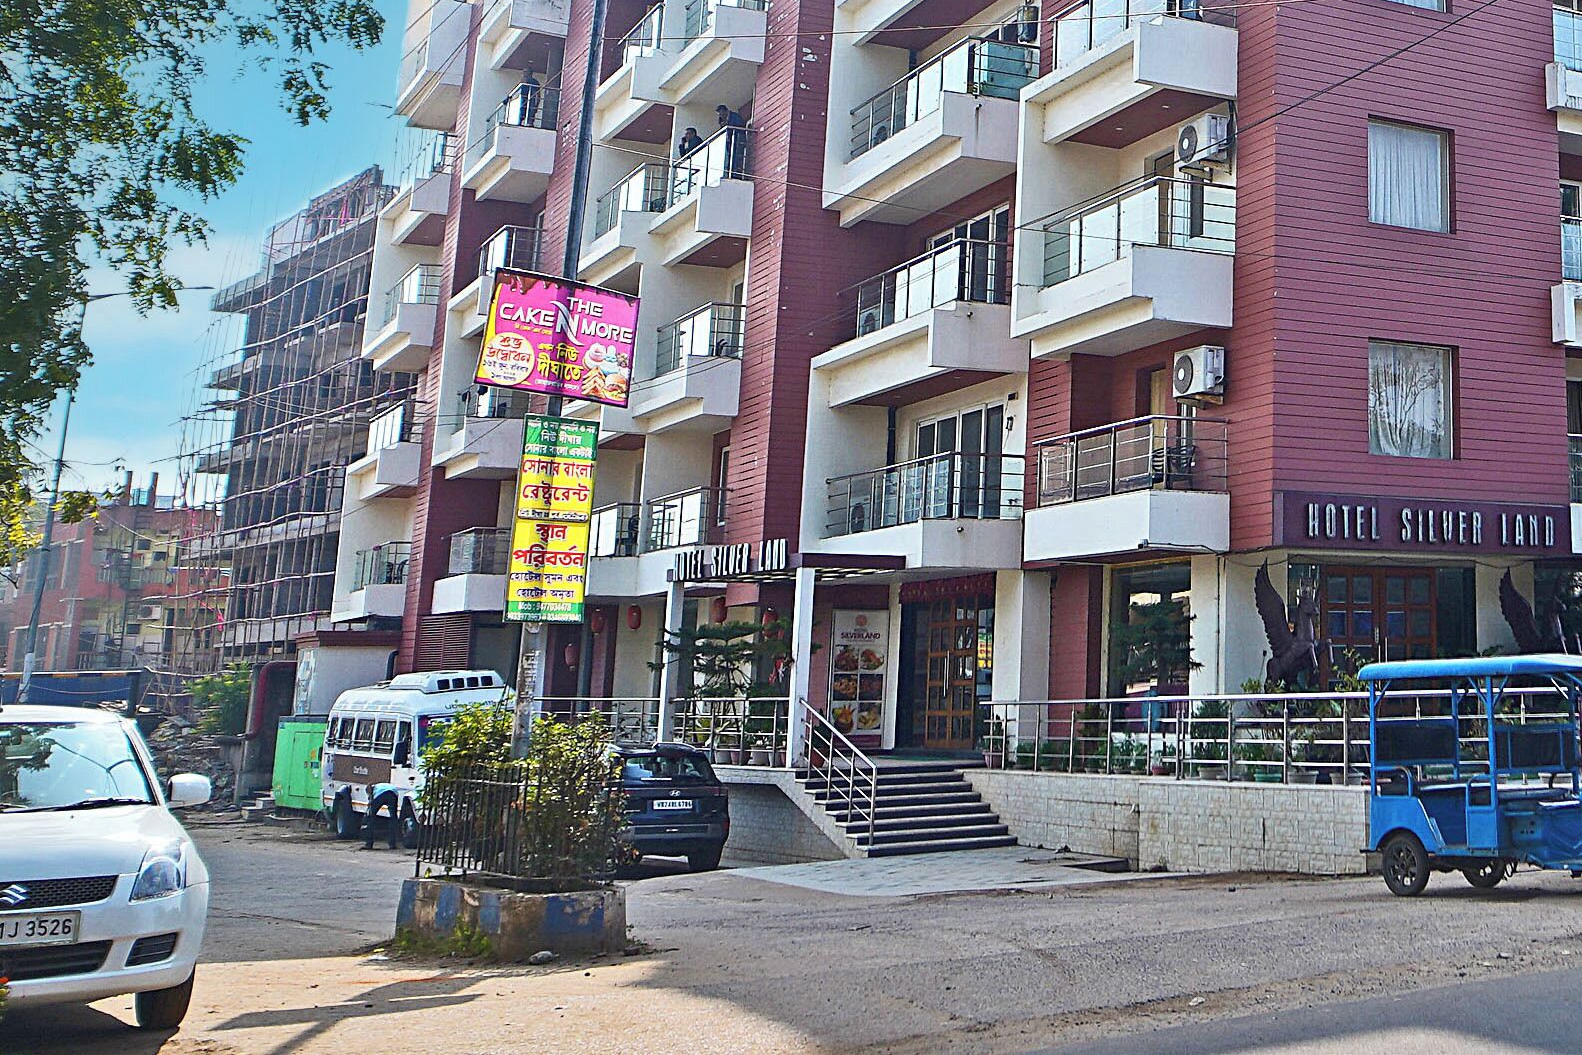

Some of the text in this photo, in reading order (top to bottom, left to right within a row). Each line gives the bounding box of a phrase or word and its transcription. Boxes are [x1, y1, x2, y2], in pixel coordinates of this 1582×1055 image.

[567, 296, 603, 317] THE
[499, 302, 556, 328] CAKE
[580, 317, 633, 344] MORE
[556, 342, 579, 362] নিউ
[537, 352, 584, 382] দীঘাতে
[522, 459, 594, 478] সোনার বাংলা
[536, 524, 567, 543] স্থান
[1307, 503, 1555, 546] HOTEL SILVER LAND
[512, 544, 585, 567] পরিবর্তন
[673, 538, 788, 581] HOTEL SILVER LAND
[510, 571, 541, 581] হোটেল
[517, 587, 547, 597] হোটেল
[25, 918, 72, 937] 3526
